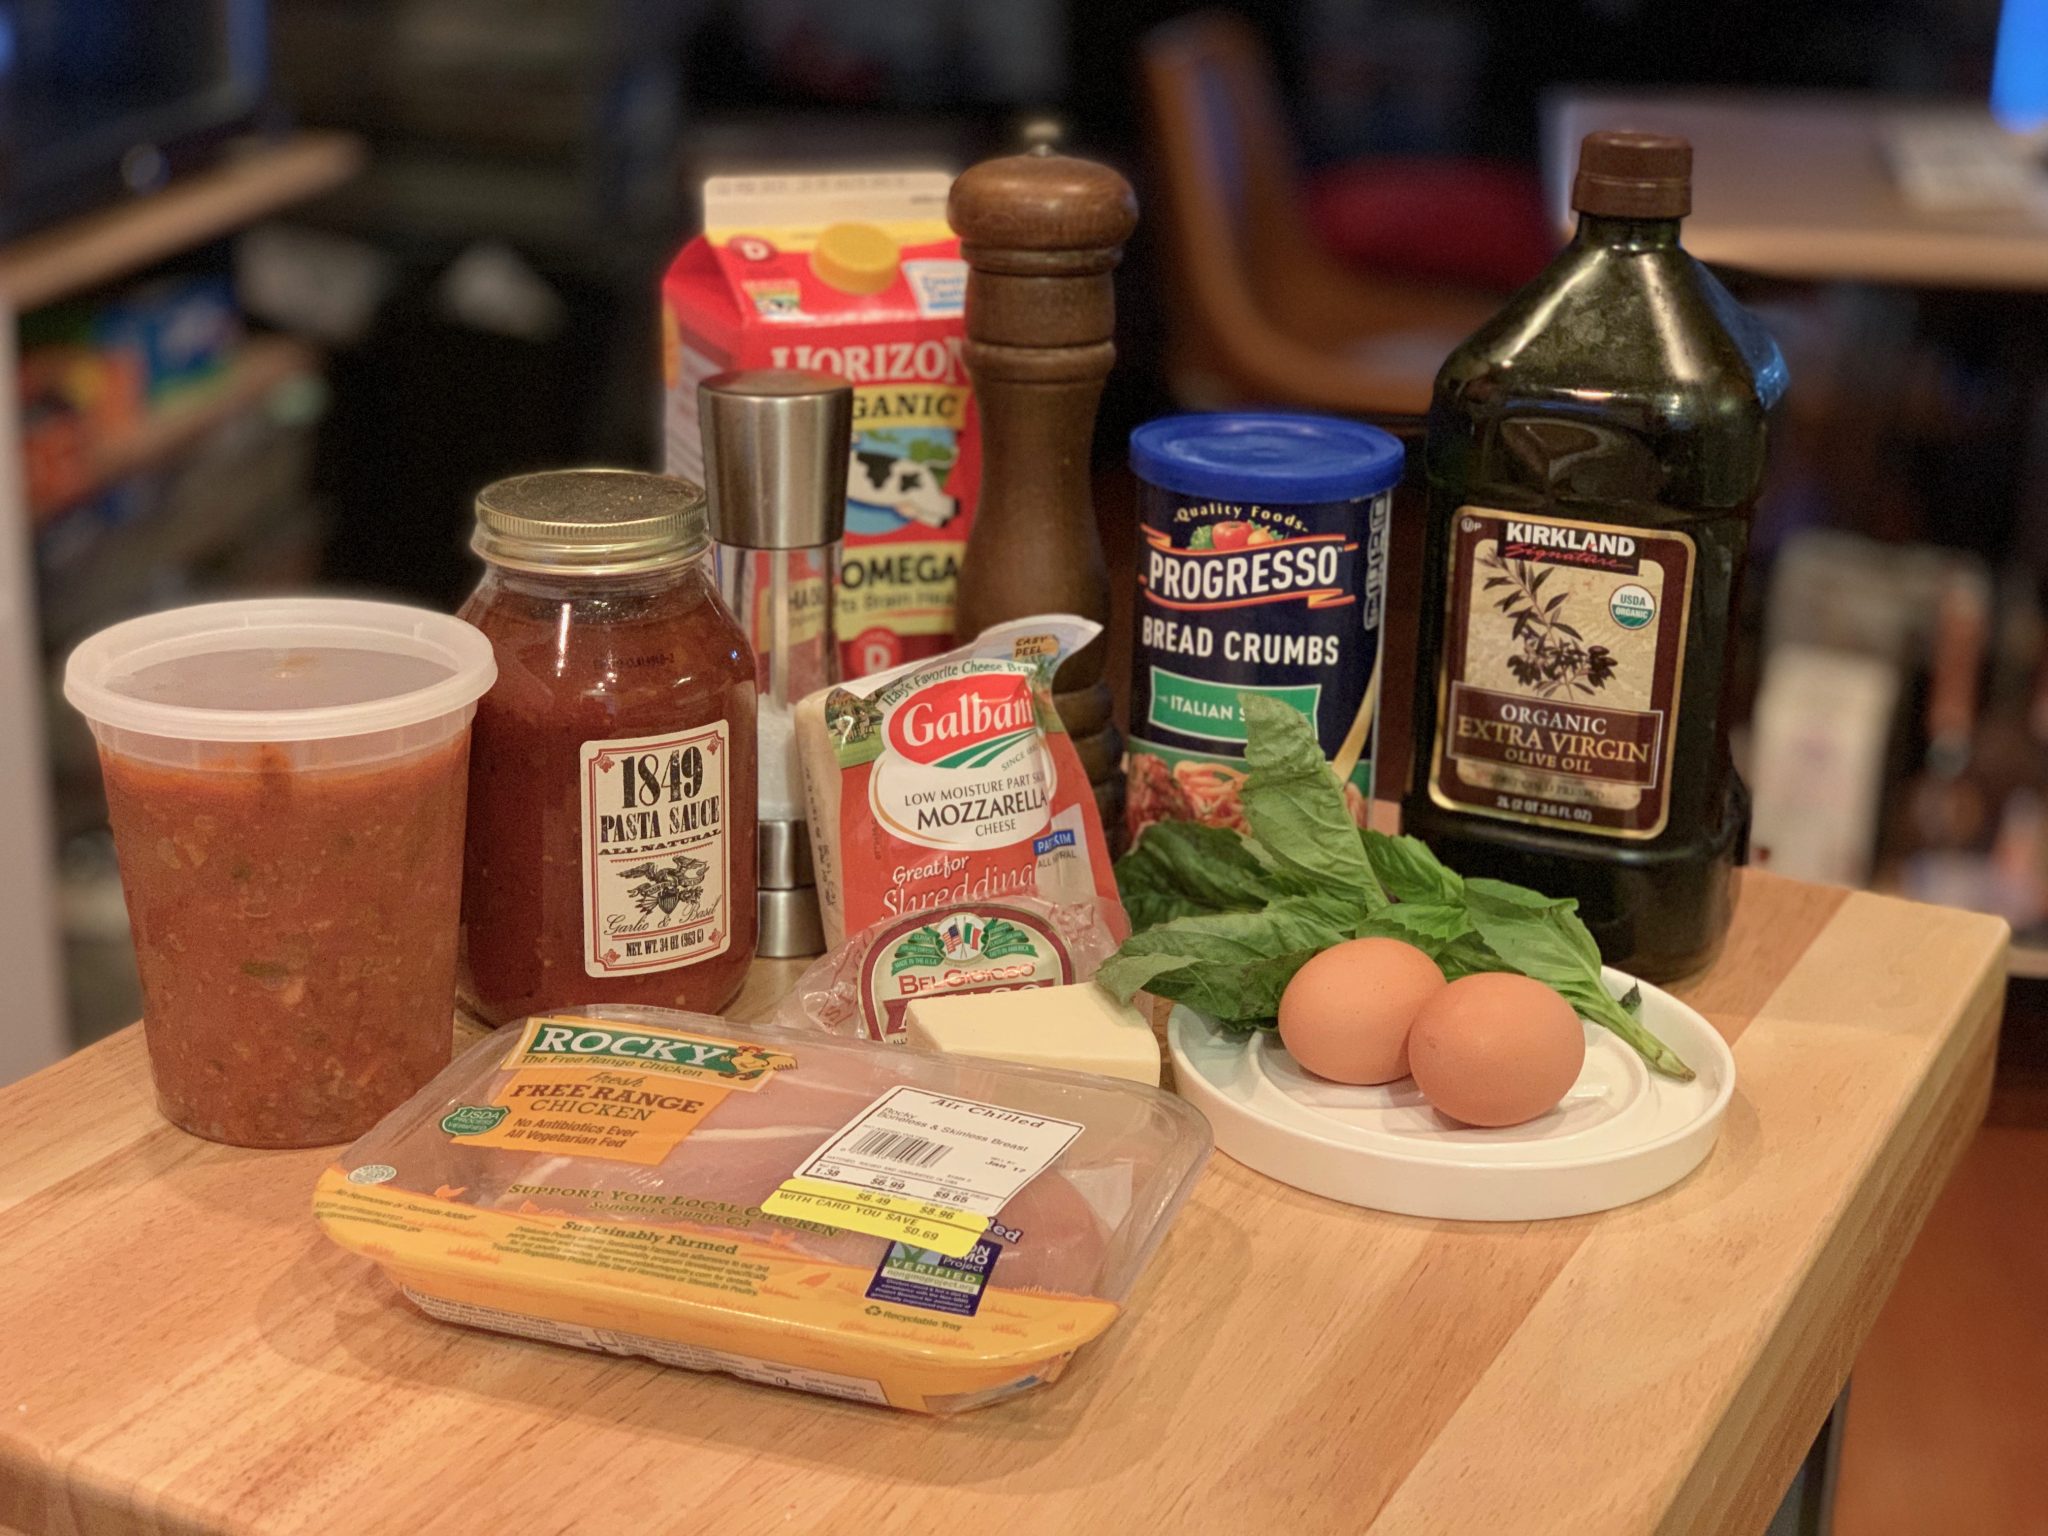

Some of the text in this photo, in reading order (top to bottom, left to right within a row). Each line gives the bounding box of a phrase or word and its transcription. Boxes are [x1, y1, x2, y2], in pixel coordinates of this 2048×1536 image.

[853, 393, 957, 419] GANIC
[1176, 502, 1303, 530] Quality Foods
[1506, 521, 1636, 558] KIRKLAND
[841, 555, 959, 590] OMEGA
[1149, 545, 1338, 600] PROGRESSO
[1620, 593, 1646, 606] USDA
[1142, 615, 1340, 666] BREAD CRUMBS
[961, 660, 1003, 676] Cheese
[901, 691, 1035, 748] Galbani
[1170, 694, 1234, 721] ITALIAN
[1500, 703, 1607, 735] ORGANIC
[1456, 715, 1650, 764] EXTRA VIRGIN
[1505, 748, 1593, 774] OLIVE OIL
[620, 746, 703, 809] 1849
[904, 791, 936, 807] LOW
[940, 779, 1004, 802] MOISTURE
[1006, 773, 1031, 790] PART
[600, 795, 720, 844] PASTA SAUCE
[916, 787, 1049, 832] MOZZARELLA
[975, 818, 1016, 838] CHEESE
[598, 829, 722, 856] ALL NATURAL
[892, 852, 971, 886] Great for
[657, 916, 671, 928] &
[679, 894, 723, 924] Basil
[660, 936, 669, 952] 34
[533, 1026, 729, 1067] ROCKY
[521, 1054, 704, 1079] The Free Range Chicken
[510, 1084, 704, 1114] FREE RANGE
[529, 1099, 657, 1122] CHICKEN
[460, 1110, 500, 1120] USDA
[881, 1106, 918, 1119] Rocky
[930, 1098, 1047, 1129] Air Chilled
[504, 1128, 628, 1150] All Vegetarian Fed
[513, 1117, 640, 1139] No Antibiotics Ever
[940, 1126, 989, 1142] Skinless
[990, 1137, 1030, 1153] Breast
[814, 1168, 842, 1178] 1.38
[870, 1177, 906, 1191] $6.99
[508, 1183, 604, 1200] SUPPORT
[609, 1190, 668, 1207] YOUR
[668, 1194, 741, 1216] LOCAL
[779, 1191, 920, 1227] WITH CARD YOU SAVE
[855, 1192, 892, 1206] $6.49
[932, 1189, 970, 1205] $9.65
[724, 1214, 754, 1229] CA
[918, 1205, 955, 1221] $8.96
[561, 1219, 663, 1245] Sustainably
[665, 1234, 739, 1256] Farmed
[902, 1225, 940, 1242] $0.69
[890, 1258, 978, 1284] VERIFIED
[942, 1257, 985, 1274] Project
[962, 1254, 989, 1266] MO
[883, 1310, 963, 1333] Recyclable Tray
